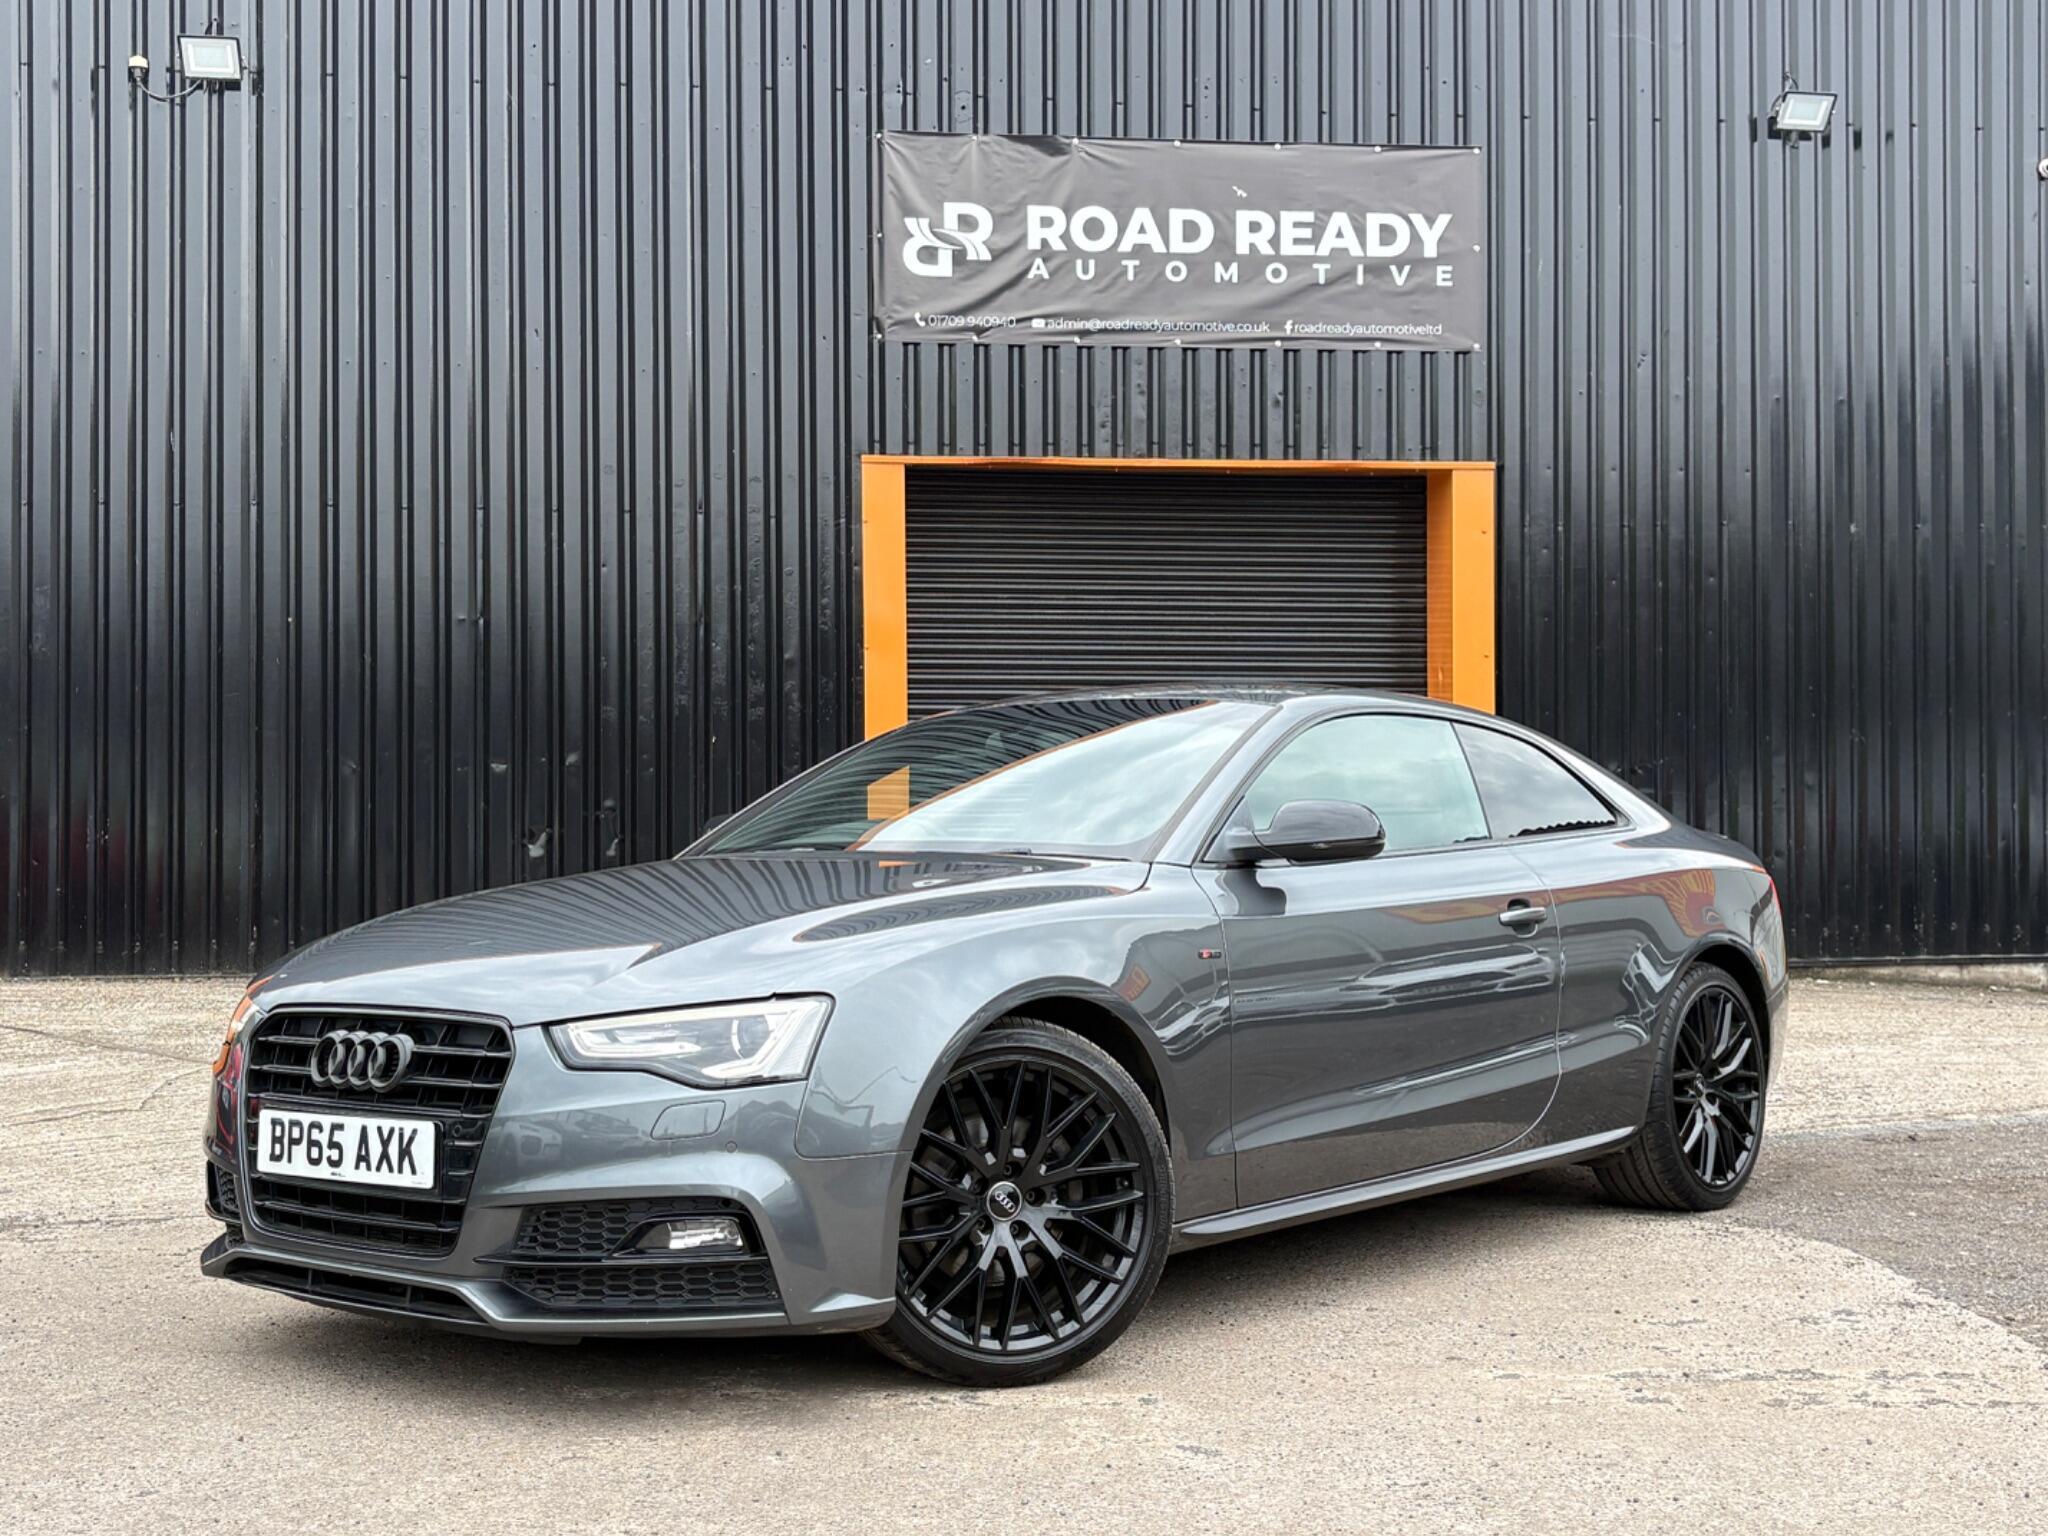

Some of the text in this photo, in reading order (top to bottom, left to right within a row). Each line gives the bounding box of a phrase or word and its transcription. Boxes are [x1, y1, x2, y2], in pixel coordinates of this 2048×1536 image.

[1026, 204, 1454, 258] ROAD READY
[1027, 257, 1454, 287] AUTOMOTIVE
[928, 314, 1017, 328] 01709 940940
[1047, 317, 1270, 333] admin@roadreadyautomotive.co.uk
[1294, 321, 1443, 336] roadreadyautomotiveltd
[269, 1117, 418, 1176] BP65 AXK
